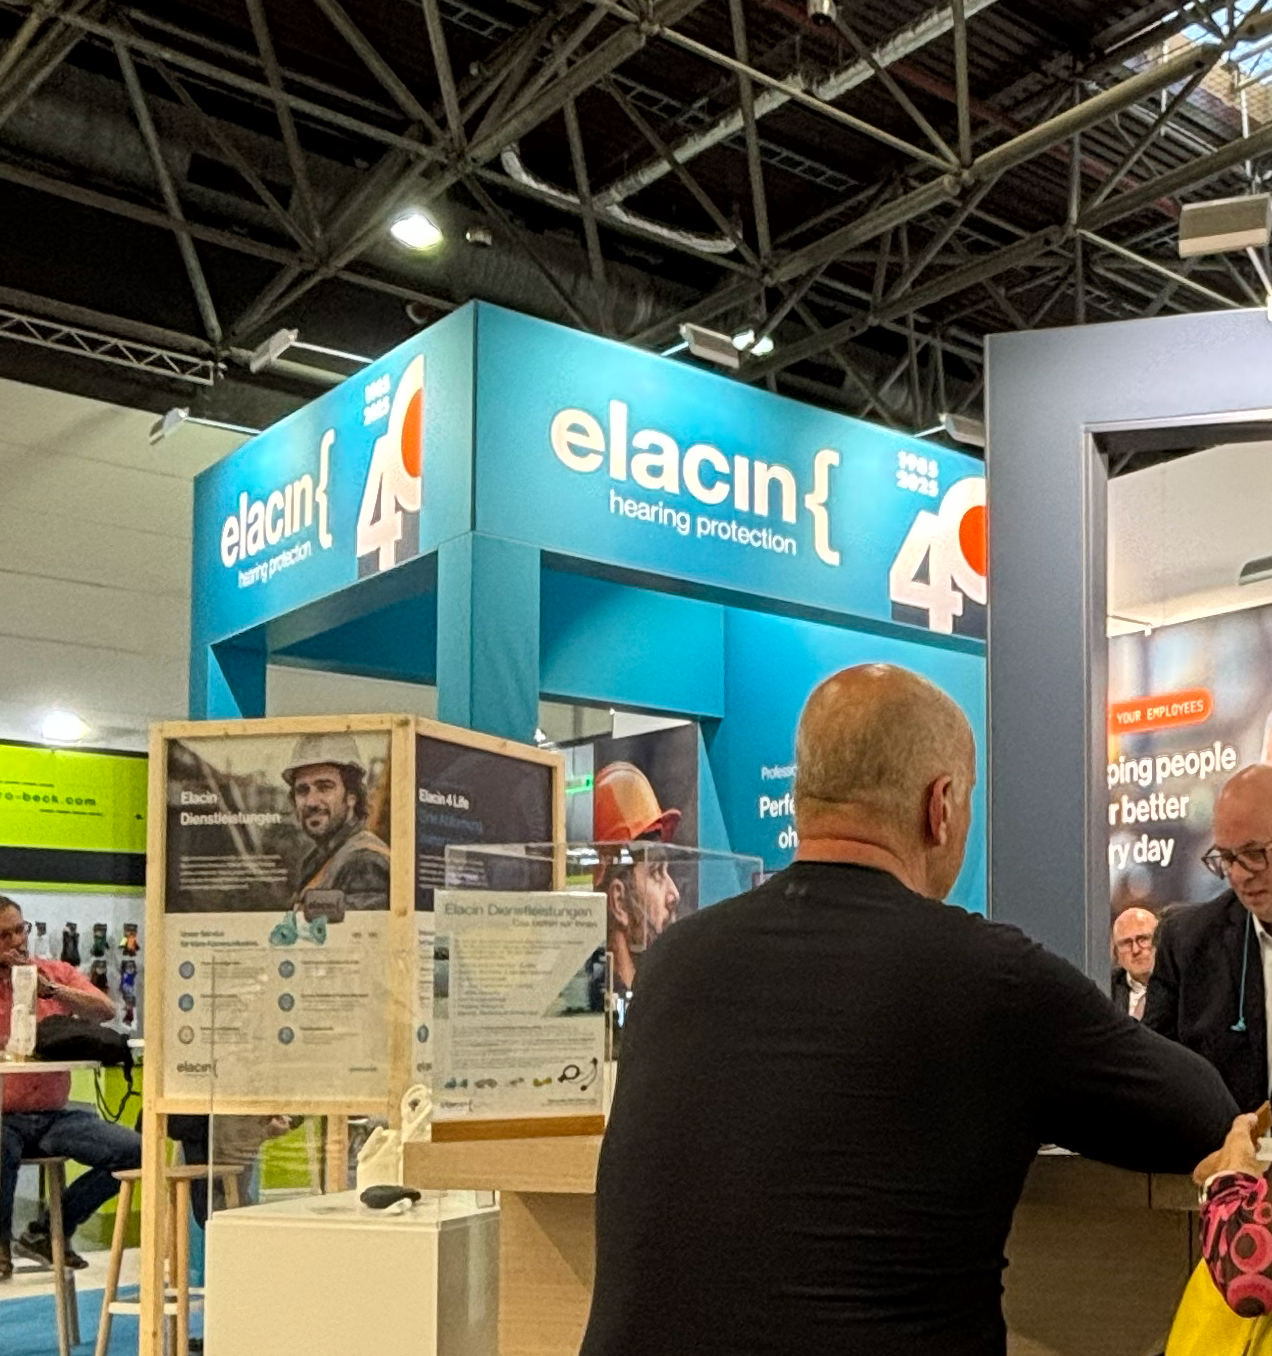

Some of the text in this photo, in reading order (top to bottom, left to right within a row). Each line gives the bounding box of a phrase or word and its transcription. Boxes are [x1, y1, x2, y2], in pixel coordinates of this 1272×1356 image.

[609, 489, 796, 556] hearing protection
[1117, 699, 1204, 725] YOUR EMPLOYEES
[1156, 741, 1237, 784] people
[0, 791, 97, 806] o-beck.com
[181, 790, 218, 805] Elacin
[1121, 792, 1190, 824] better
[181, 811, 281, 826] Dienstleistungen
[1133, 834, 1175, 867] day
[445, 903, 484, 917] Elacin
